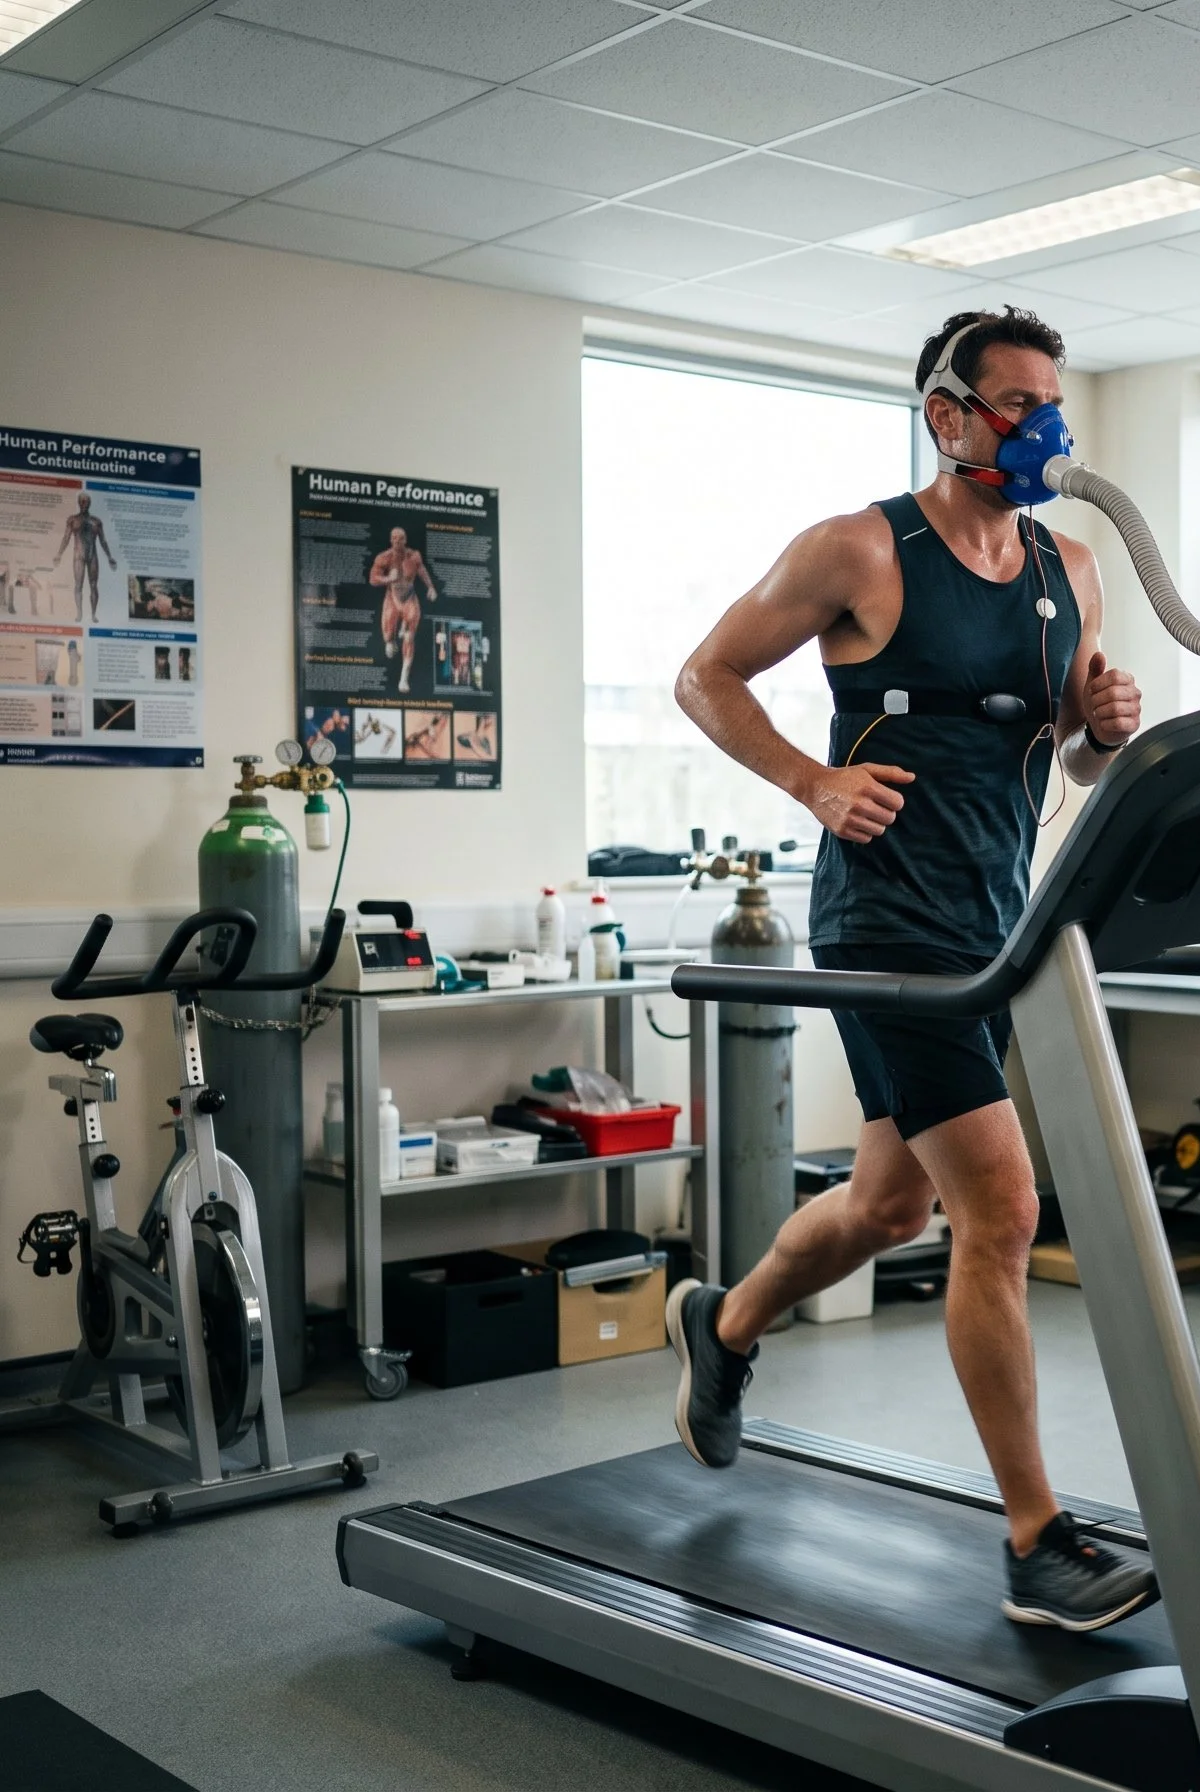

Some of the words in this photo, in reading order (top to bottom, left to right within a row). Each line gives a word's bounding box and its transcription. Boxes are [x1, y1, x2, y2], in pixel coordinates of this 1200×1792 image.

[0, 431, 58, 452] Human
[62, 439, 166, 463] Performance
[309, 472, 372, 496] Human
[376, 480, 485, 508] Performance
